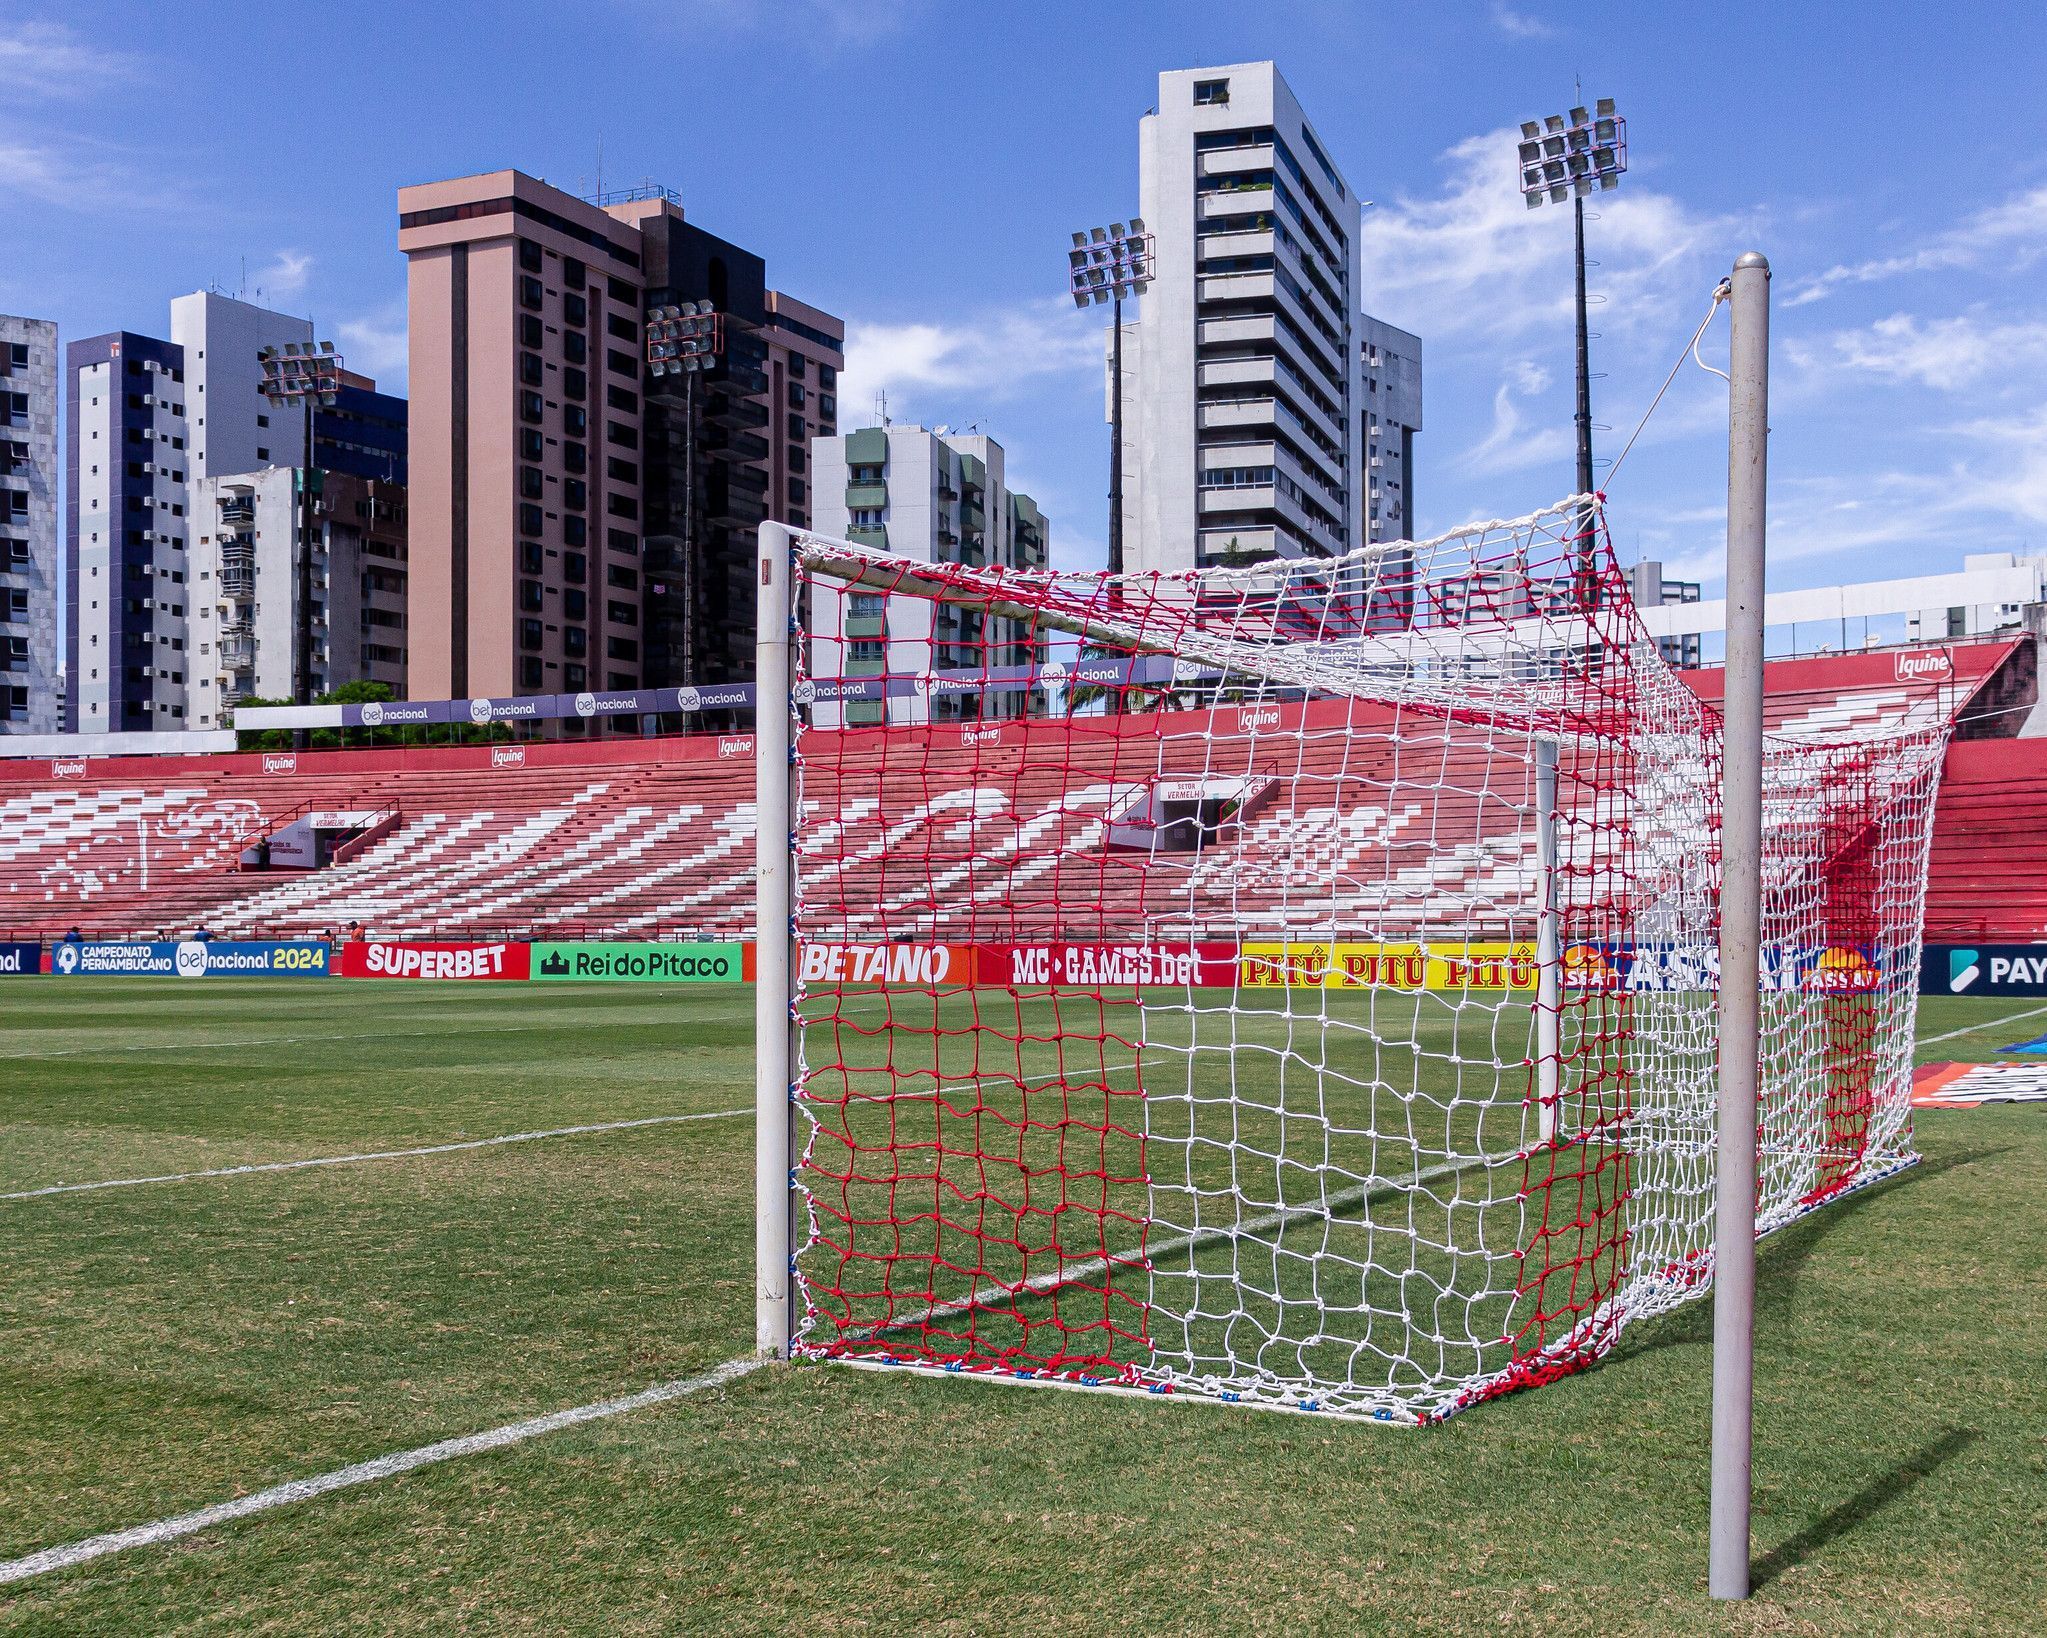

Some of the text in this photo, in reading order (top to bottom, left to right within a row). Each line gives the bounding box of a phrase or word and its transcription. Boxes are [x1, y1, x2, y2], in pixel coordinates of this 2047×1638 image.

[1898, 652, 1948, 677] Iquine
[1241, 710, 1279, 729] Iquine
[493, 748, 524, 765] Iquine
[721, 739, 752, 757] Iquine
[53, 761, 84, 776] Iquine
[265, 756, 295, 772] Iquine
[81, 946, 151, 958] CAMPEONATO
[273, 949, 324, 969] 2024
[366, 944, 506, 978] SUPERBET
[81, 957, 172, 971] PERNAMBUCANO
[576, 952, 729, 977] Rei do Pitaco
[802, 945, 949, 983] BETANO
[1244, 945, 1535, 987] PITÚ PITÚ PITÚ
